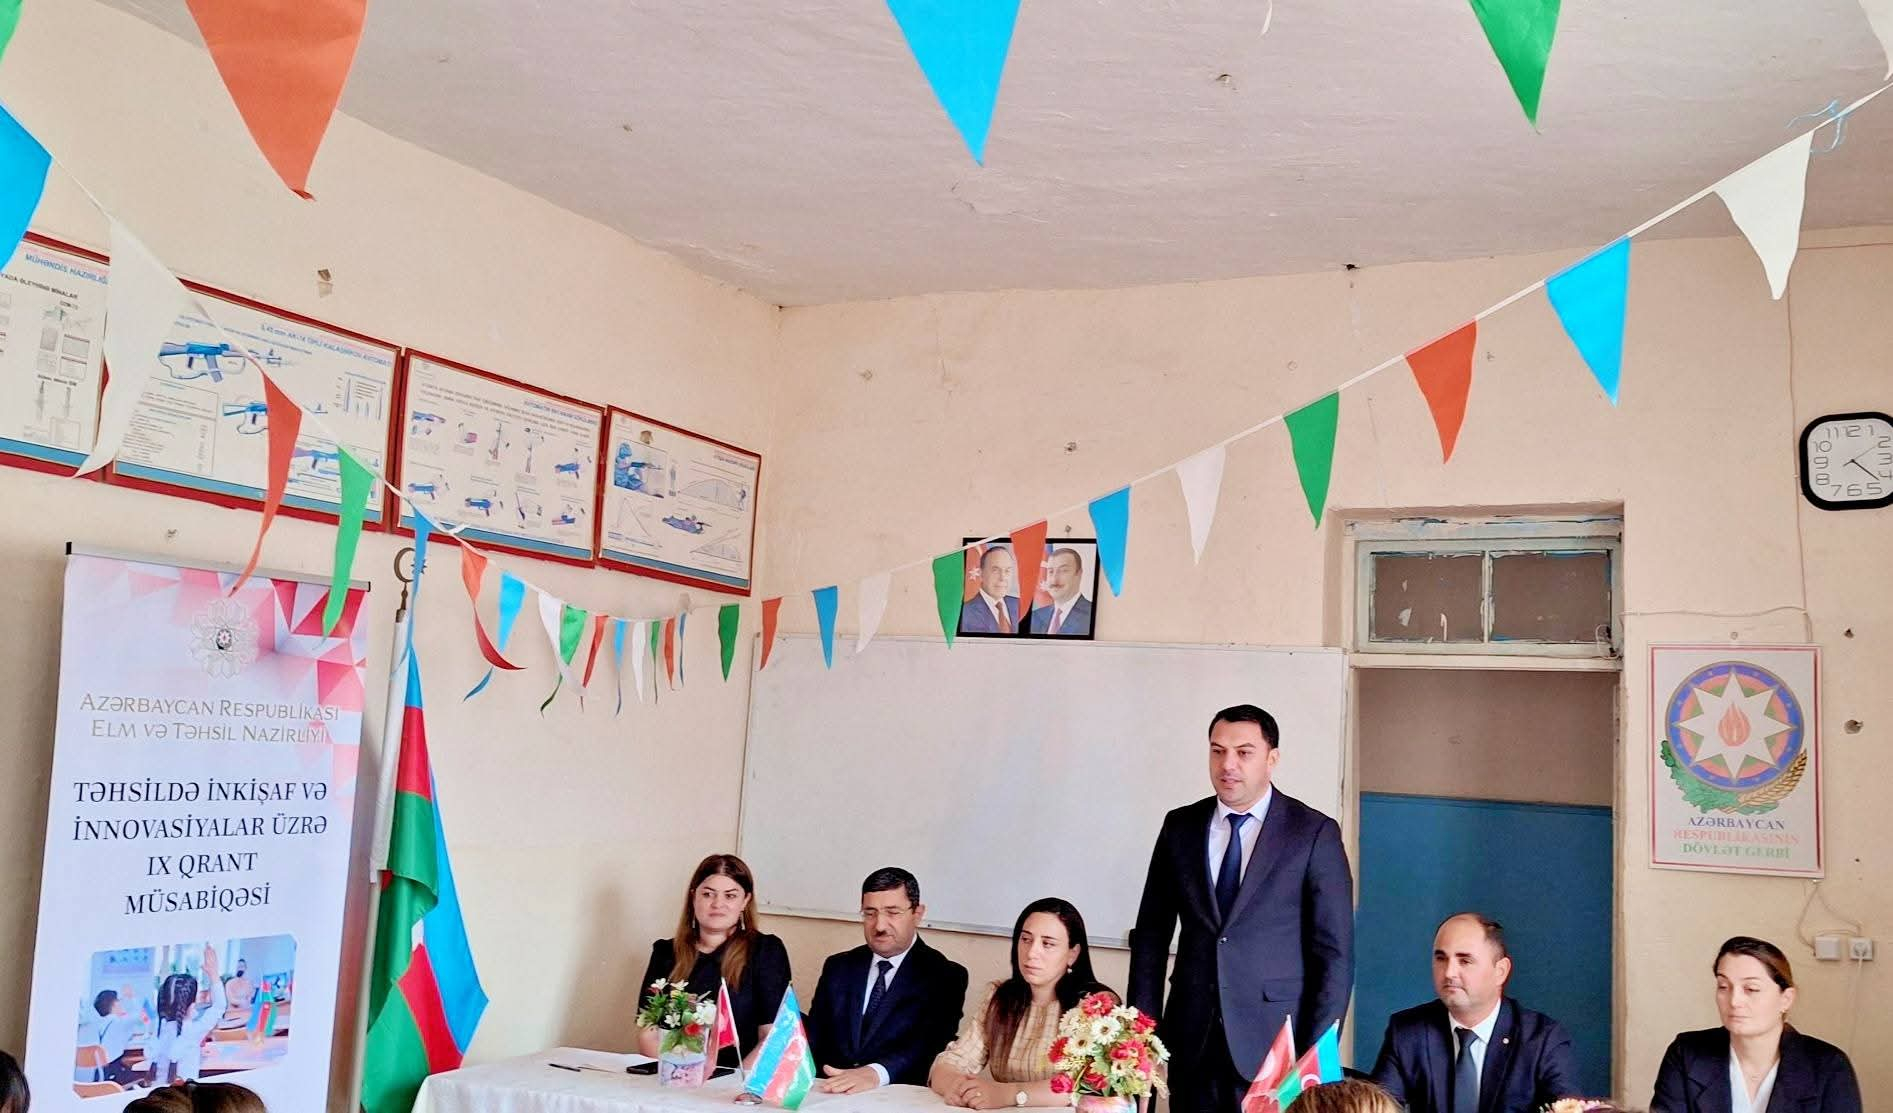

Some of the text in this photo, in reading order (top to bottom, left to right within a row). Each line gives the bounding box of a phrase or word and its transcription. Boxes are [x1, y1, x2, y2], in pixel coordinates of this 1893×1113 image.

[1825, 426, 1839, 439] 11
[1842, 424, 1862, 438] 12
[1813, 440, 1832, 453] 10
[1877, 435, 1892, 449] 2
[1813, 456, 1829, 469] 9
[1877, 452, 1893, 466] 3
[1815, 472, 1830, 486] 8
[1830, 484, 1842, 497] 7
[1846, 483, 1863, 497] 6
[1866, 481, 1883, 495] 5
[73, 777, 327, 806] TƏHSİLDƏ İNKİŞAF VƏ
[73, 812, 328, 841] İNNOVASİYALAR ÜZRƏ
[1688, 816, 1785, 830] AZƏRBAYCAN
[146, 852, 258, 879] IX QRANT
[124, 882, 271, 915] MÜSABİQƏSİ
